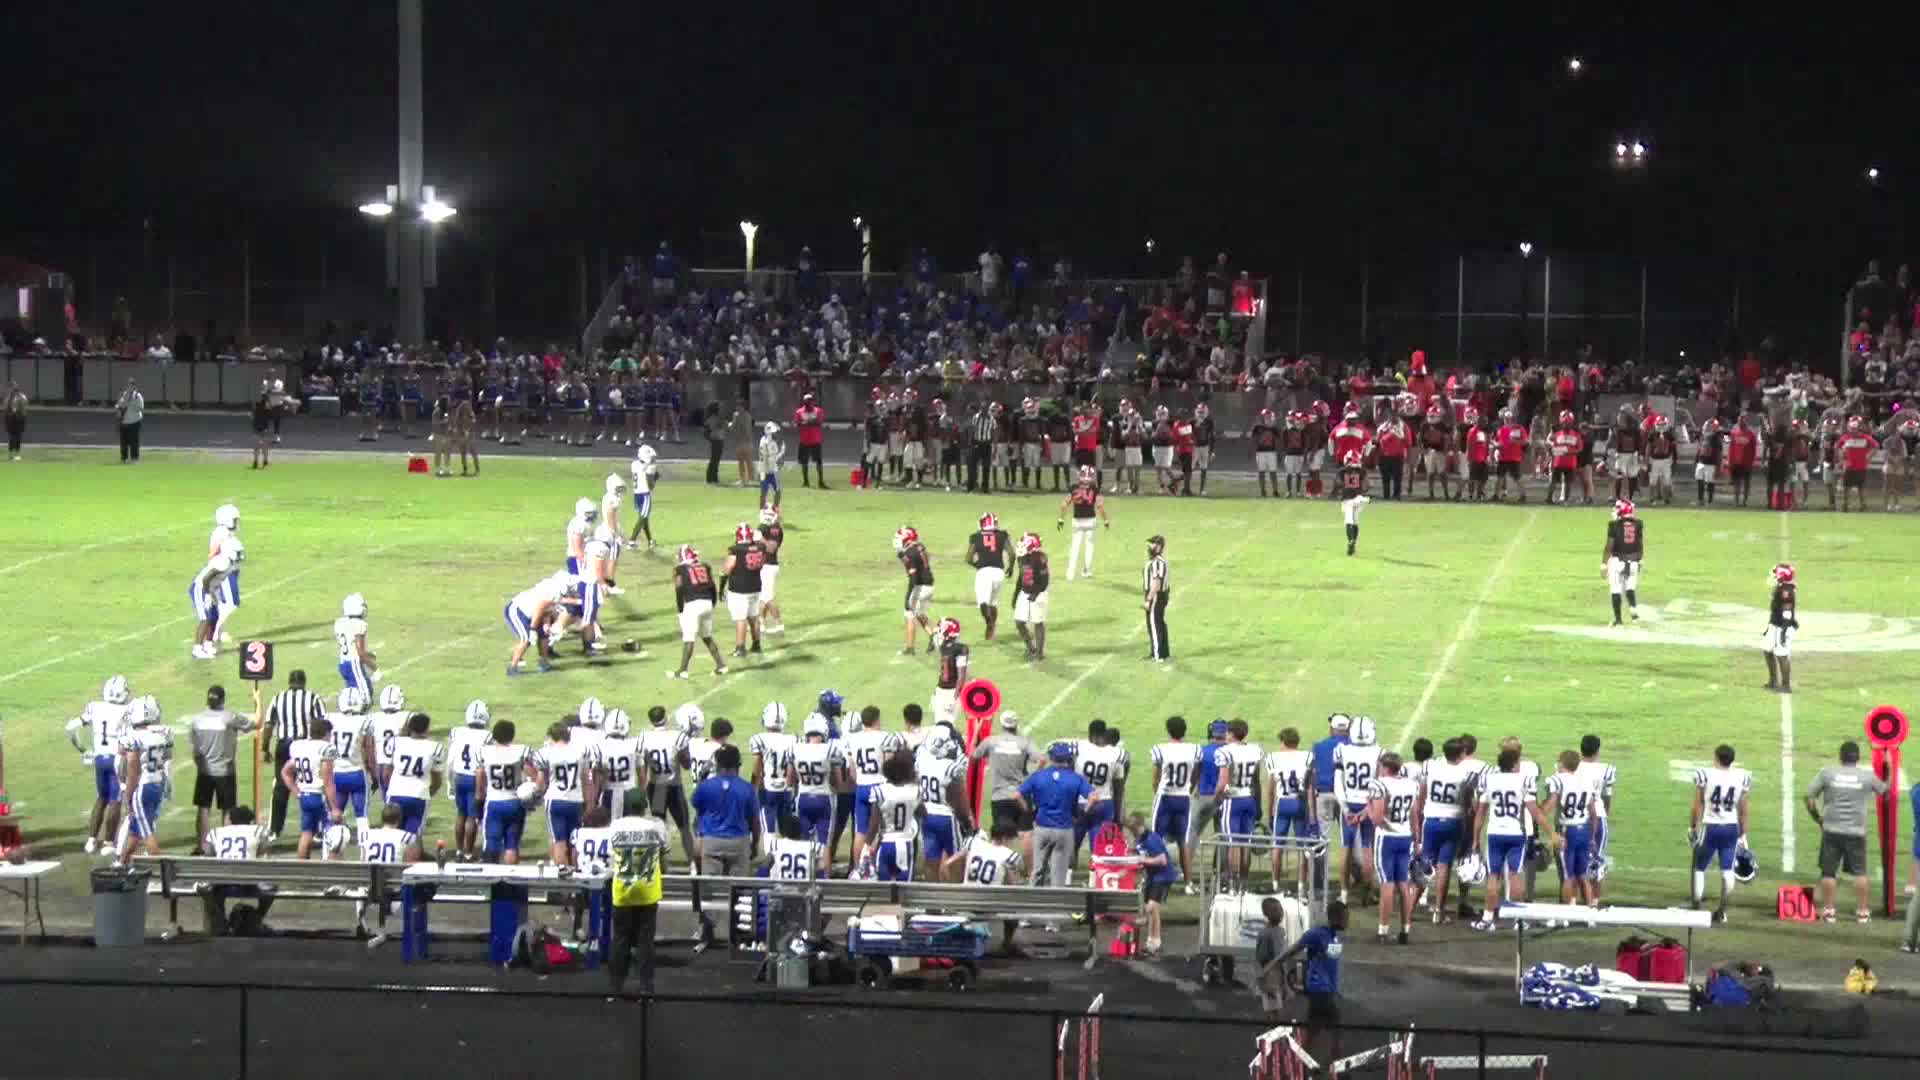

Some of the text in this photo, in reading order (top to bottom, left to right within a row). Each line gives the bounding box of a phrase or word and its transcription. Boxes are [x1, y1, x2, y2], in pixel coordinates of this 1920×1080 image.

[983, 534, 997, 553] 4
[244, 640, 266, 672] 3
[101, 720, 109, 746] 1
[332, 731, 353, 758] 17
[400, 755, 424, 778] 74
[461, 744, 471, 770] 4
[607, 756, 630, 783] 12
[856, 748, 879, 773] 45
[490, 764, 514, 790] 58
[555, 763, 579, 791] 97
[1083, 761, 1108, 786] 99
[1166, 762, 1188, 788] 10
[1235, 762, 1255, 788] 15
[1278, 770, 1299, 795] 14
[1346, 762, 1370, 790] 32
[920, 775, 940, 803] 89
[1430, 780, 1456, 805] 66
[1710, 785, 1735, 813] 44
[895, 803, 906, 831] 0
[1391, 795, 1413, 823] 87
[1491, 791, 1518, 818] 36
[1563, 791, 1588, 819] 84
[221, 837, 248, 858] 23
[369, 843, 395, 861] 20
[583, 839, 609, 866] 94
[780, 853, 806, 879] 26
[967, 856, 996, 884] 30
[1101, 872, 1119, 890] G
[1781, 887, 1812, 918] 50
